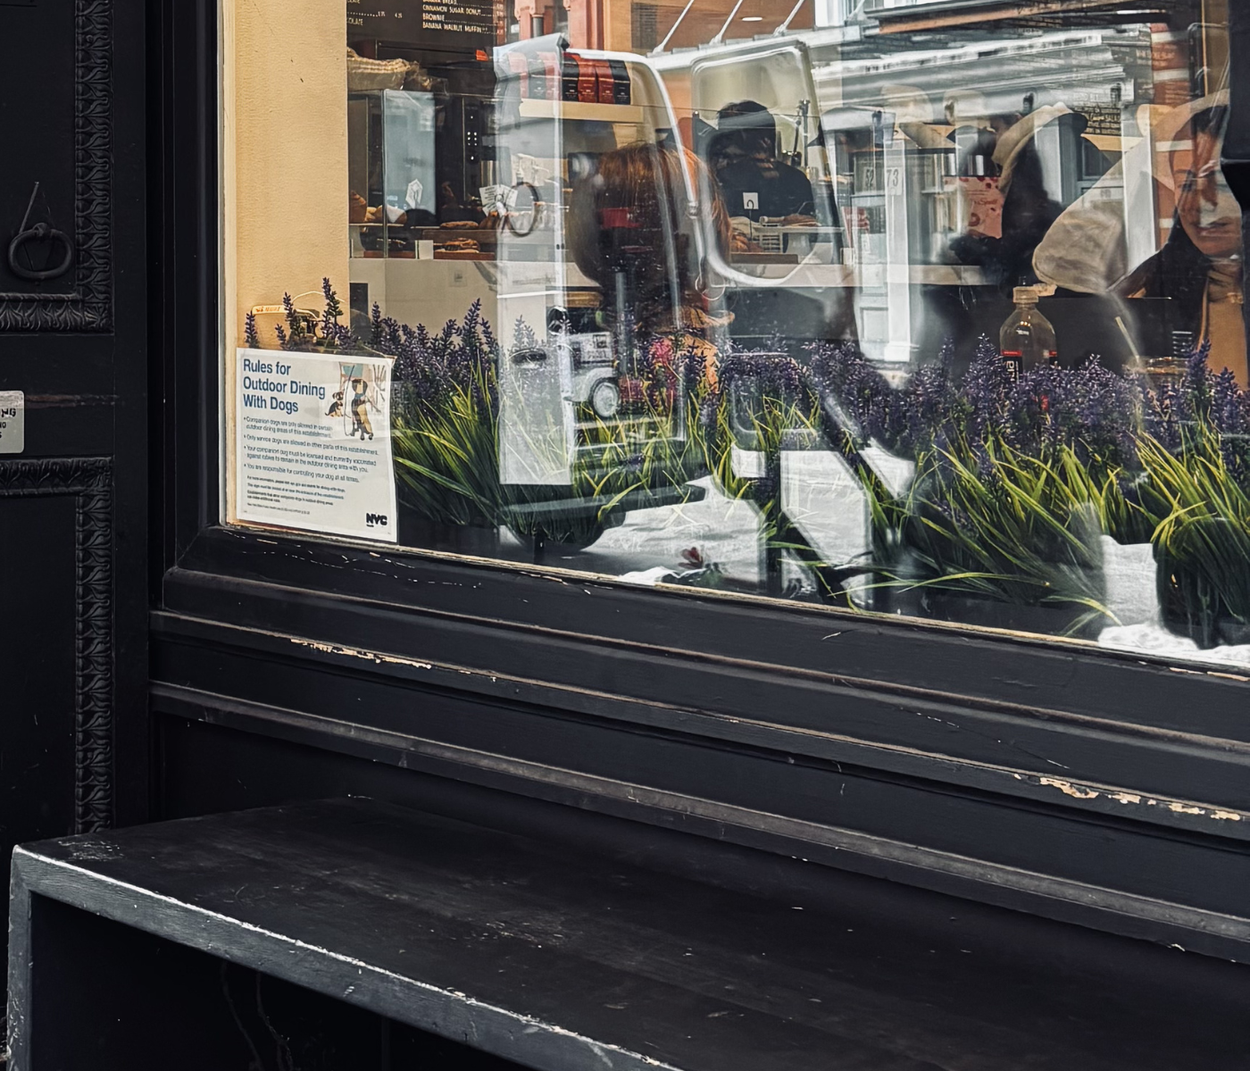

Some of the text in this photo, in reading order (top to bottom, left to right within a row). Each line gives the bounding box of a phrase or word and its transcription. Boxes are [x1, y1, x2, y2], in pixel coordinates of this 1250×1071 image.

[243, 359, 291, 376] Rules for
[243, 376, 325, 399] Outdoor Dining
[243, 393, 299, 415] With Dogs
[366, 512, 387, 526] NYC
